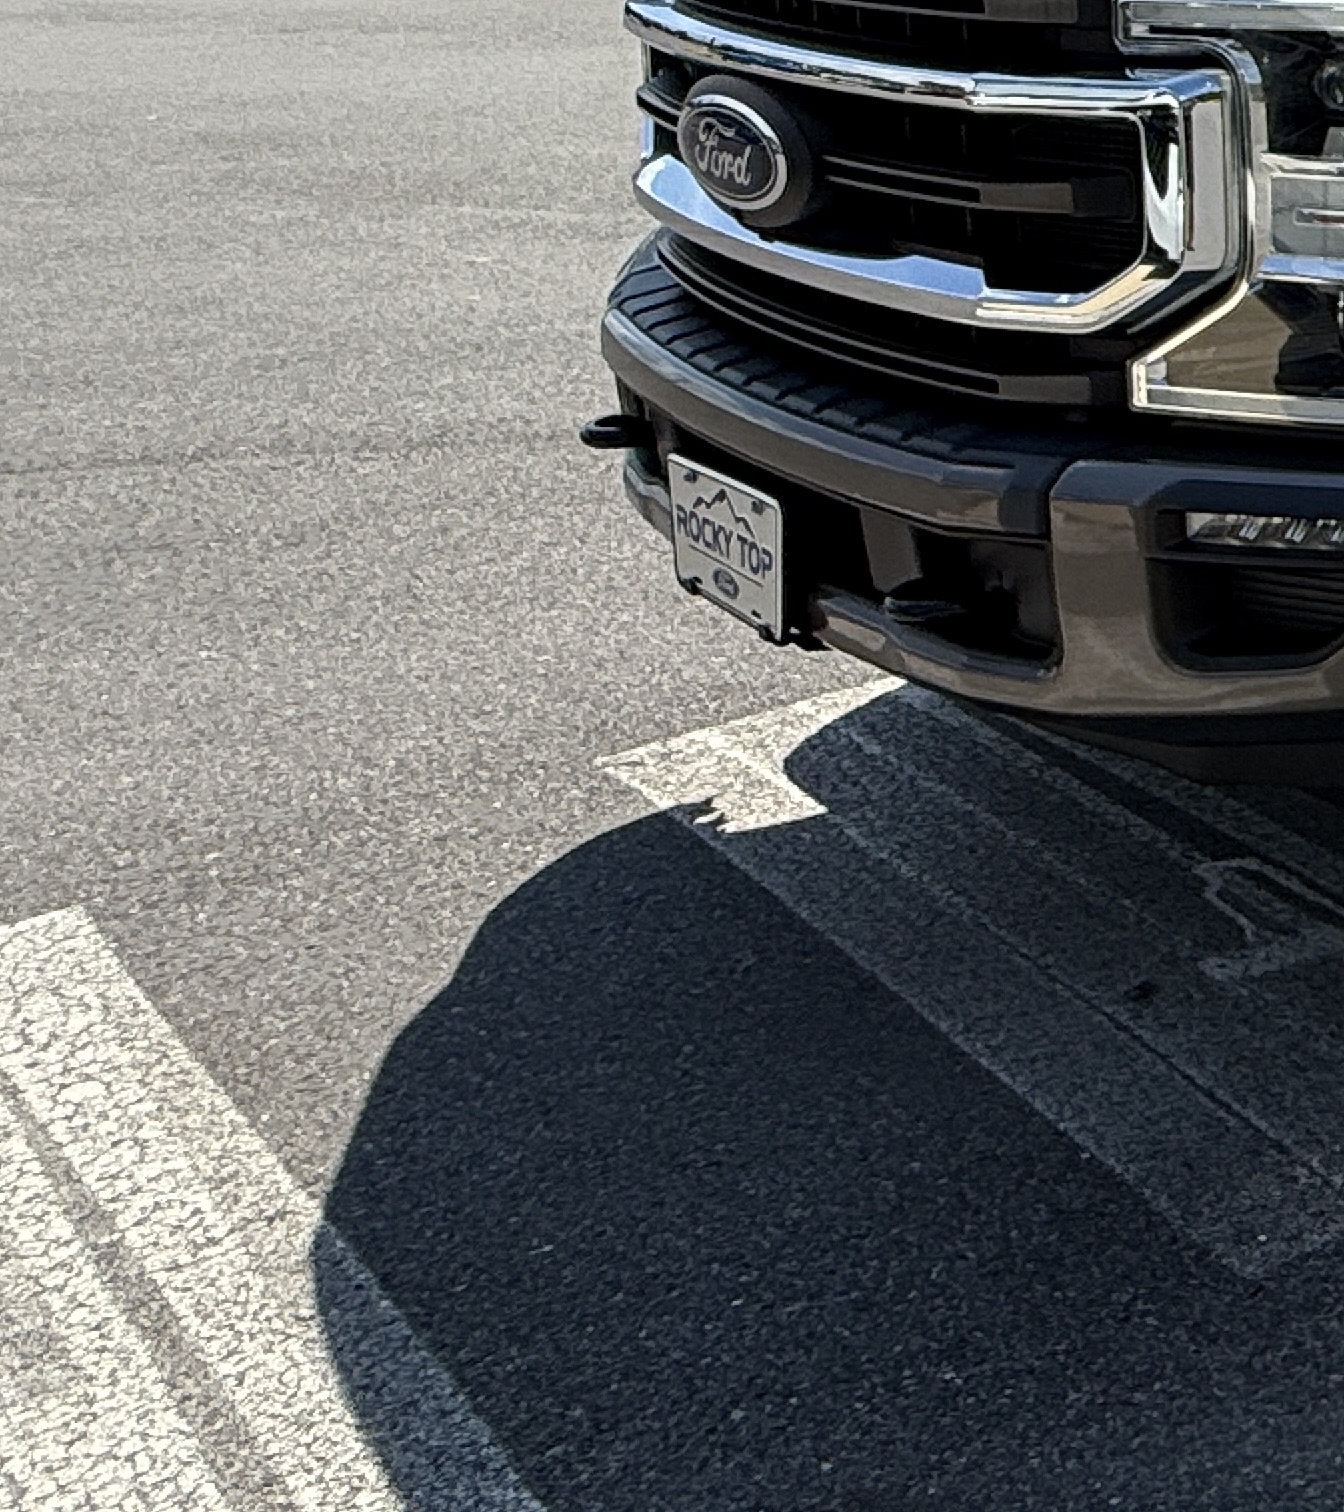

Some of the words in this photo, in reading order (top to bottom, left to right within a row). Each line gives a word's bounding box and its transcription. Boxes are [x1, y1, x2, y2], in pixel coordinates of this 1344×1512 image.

[695, 116, 752, 186] Ford
[676, 503, 733, 560] ROCKY
[736, 532, 773, 579] TOP
